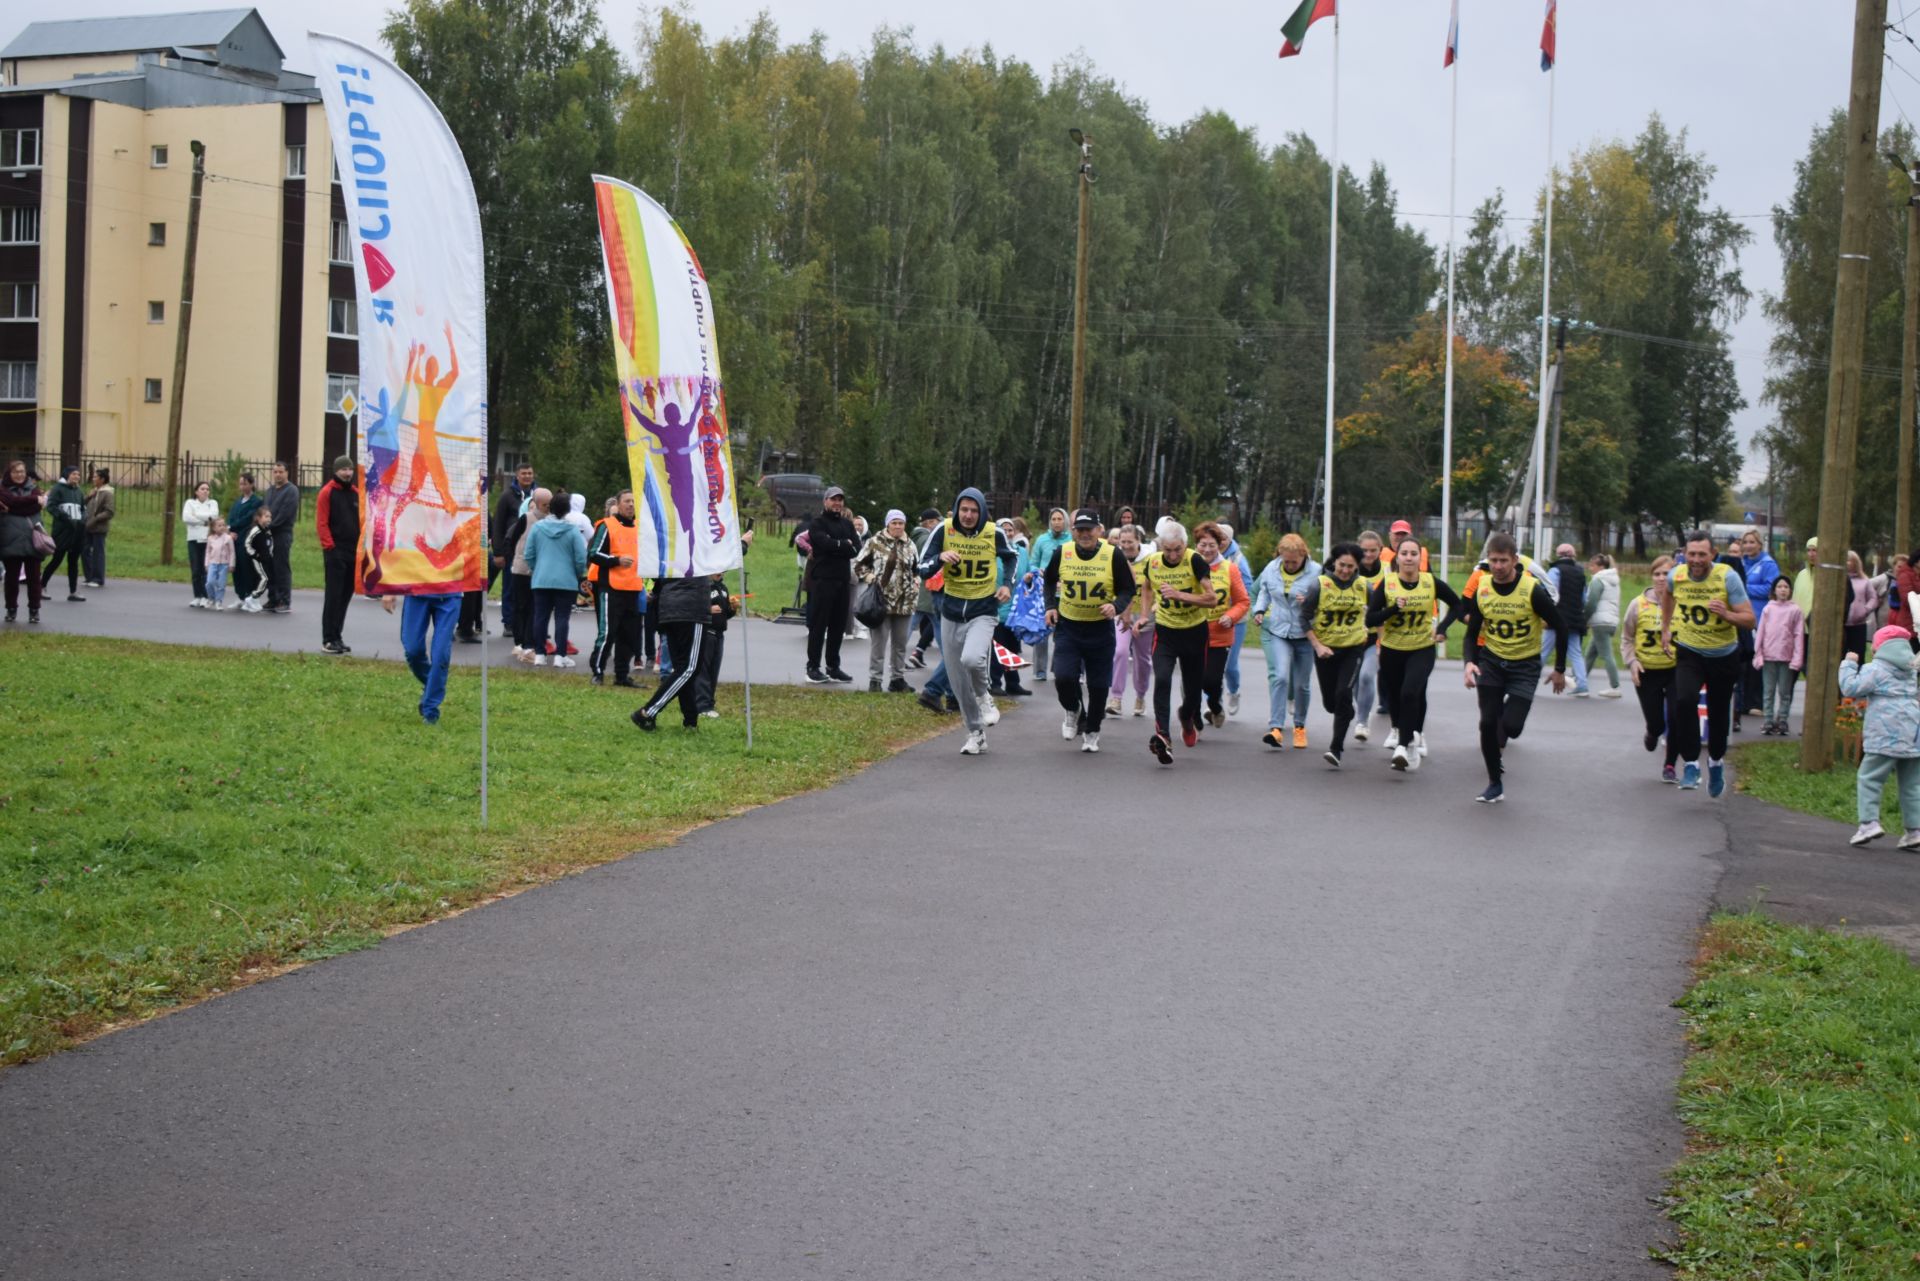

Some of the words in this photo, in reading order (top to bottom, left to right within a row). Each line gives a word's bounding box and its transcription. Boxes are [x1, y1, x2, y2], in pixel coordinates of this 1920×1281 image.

[336, 64, 391, 240] СПОРТ!
[372, 298, 394, 327] Я
[949, 542, 991, 551] ТУКАЕВСКИЙ
[947, 559, 991, 579] 315
[1063, 580, 1107, 601] 314
[1391, 610, 1427, 629] 317
